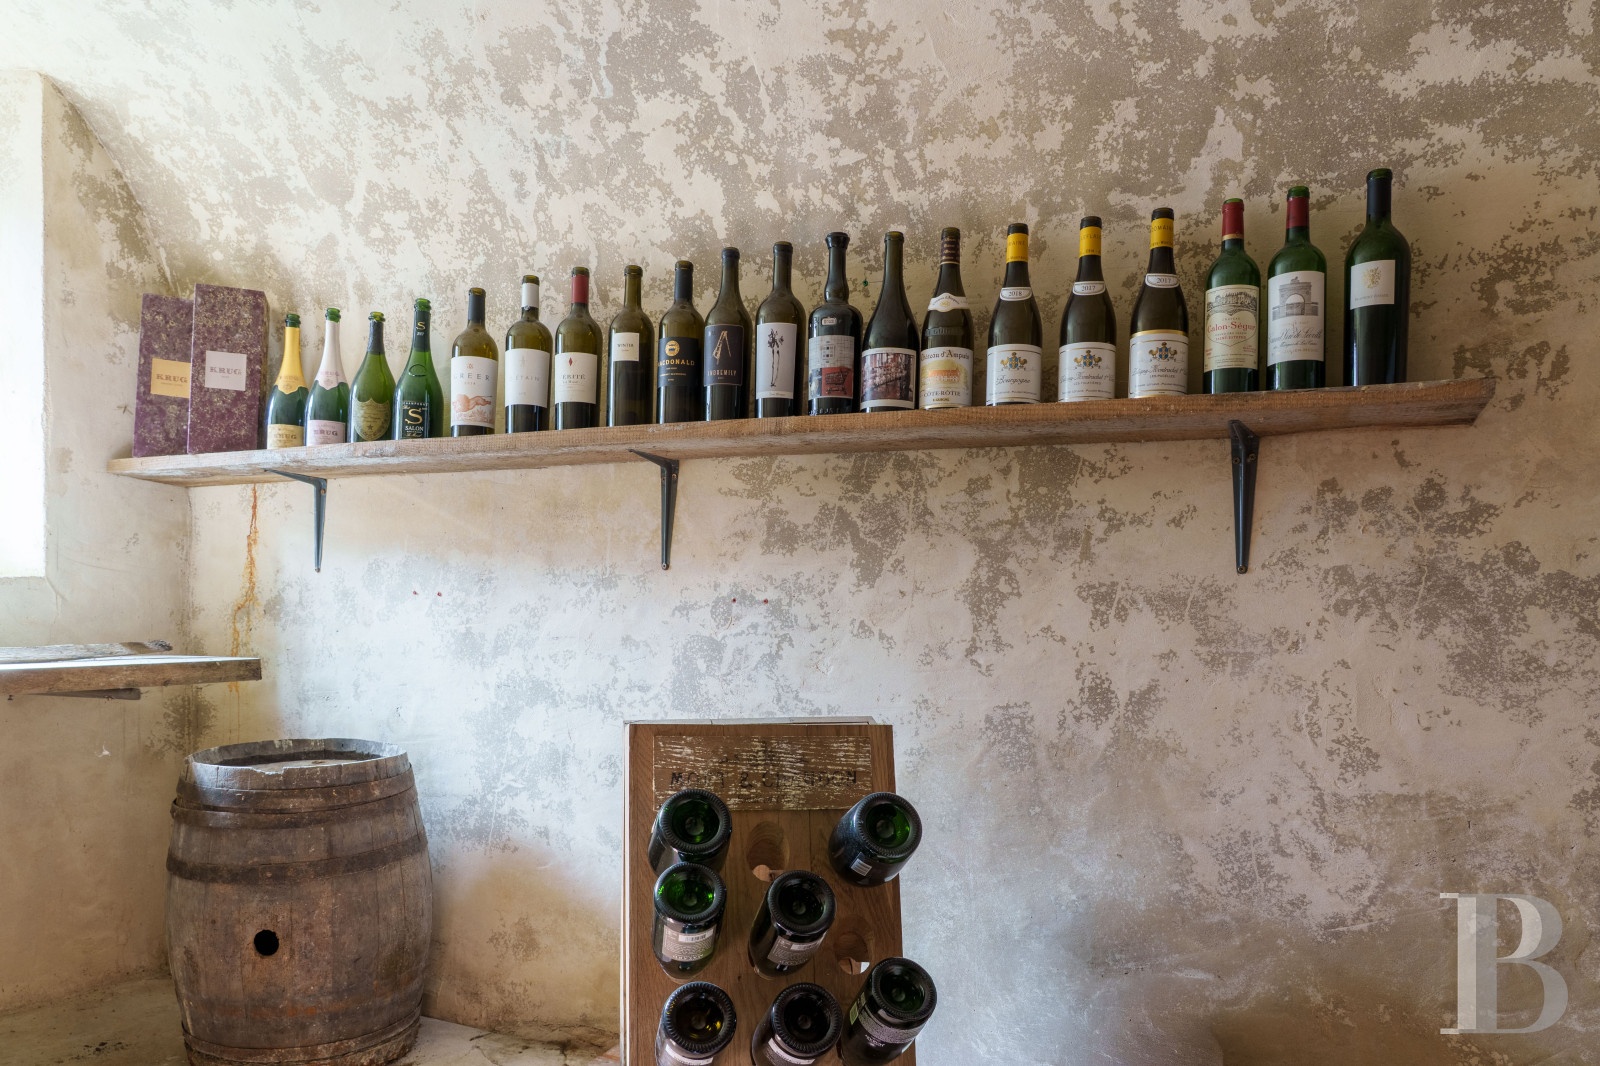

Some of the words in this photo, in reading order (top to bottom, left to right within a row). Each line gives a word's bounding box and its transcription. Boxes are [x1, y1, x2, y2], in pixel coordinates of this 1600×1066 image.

[1207, 321, 1256, 334] Calon-Ségur
[210, 366, 242, 376] KRUG
[155, 373, 188, 383] KRUG
[404, 408, 423, 424] S
[313, 429, 338, 437] KRUG
